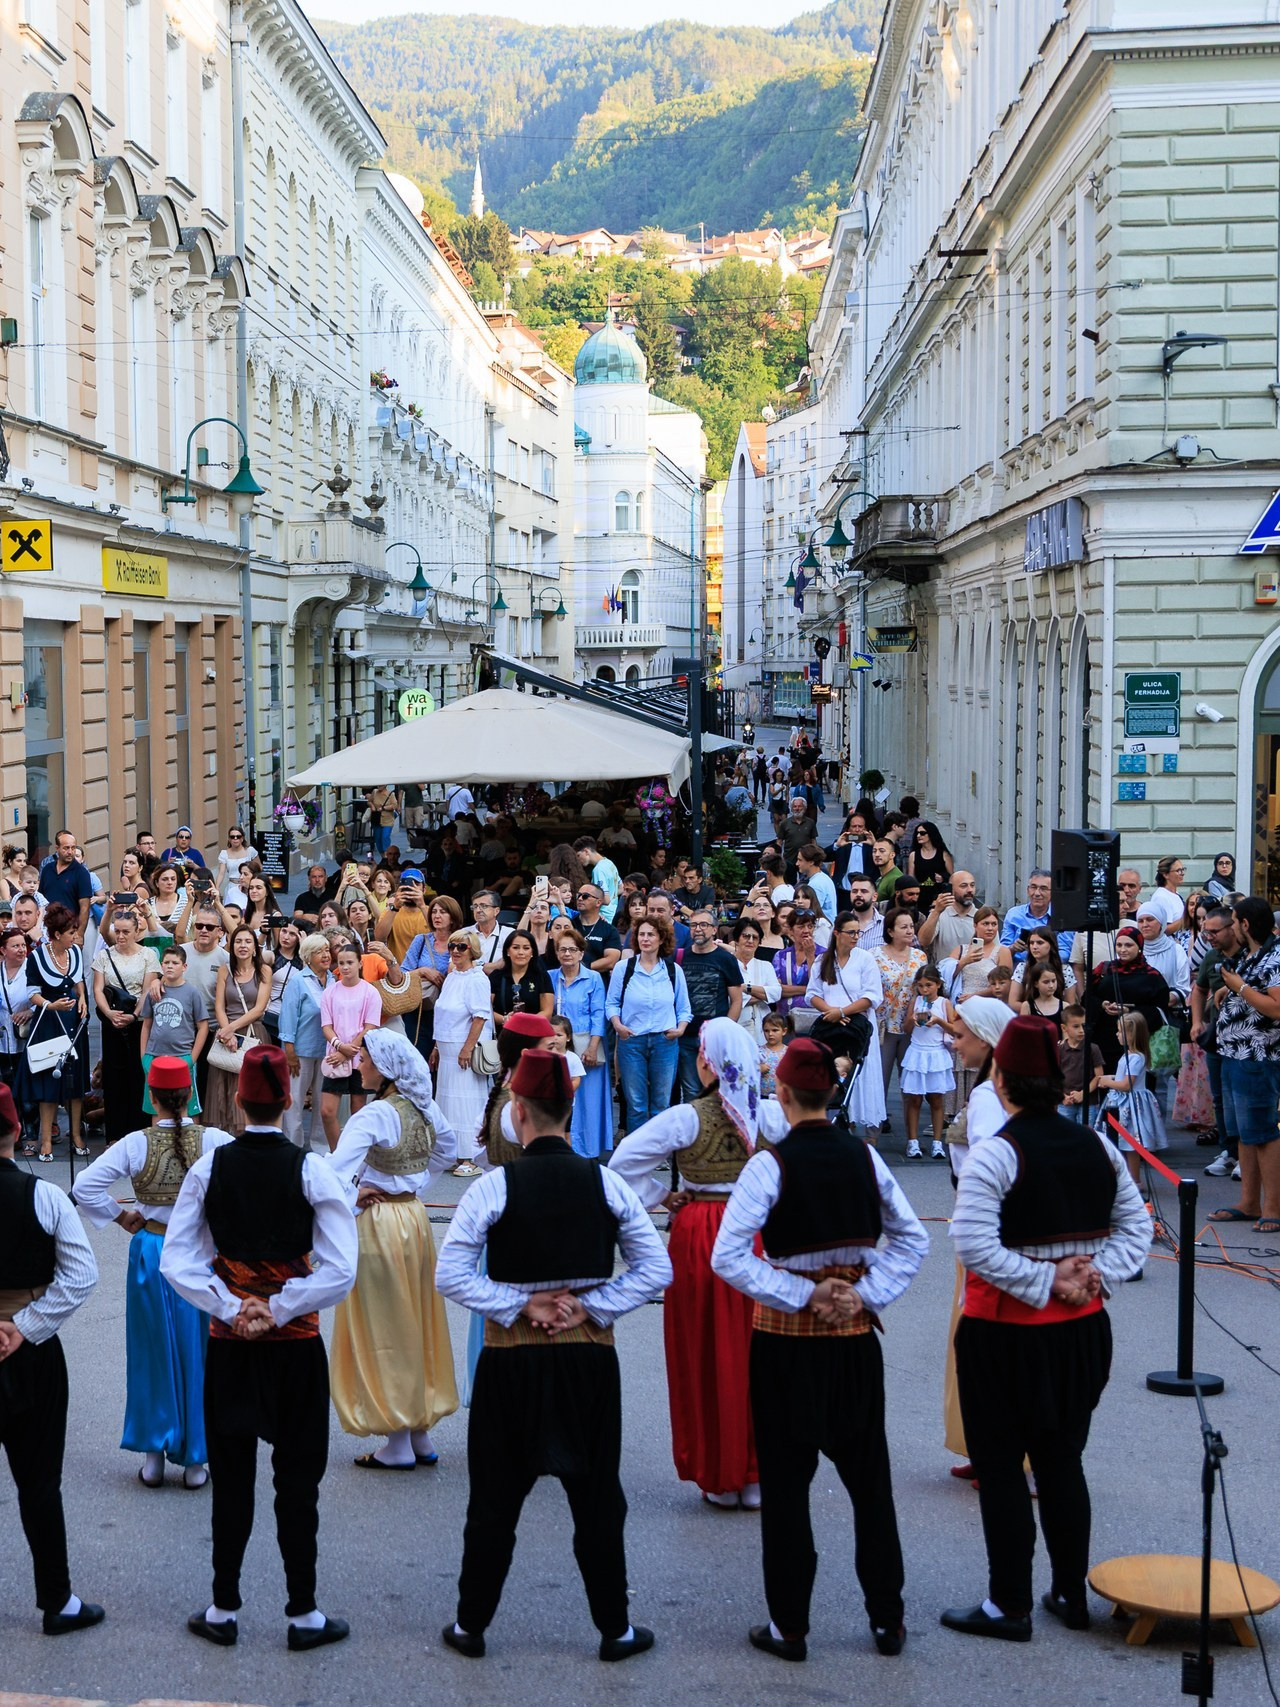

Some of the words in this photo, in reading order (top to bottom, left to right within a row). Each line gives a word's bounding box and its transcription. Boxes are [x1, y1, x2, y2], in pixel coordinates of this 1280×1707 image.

[122, 561, 148, 584] Raiffeisen
[148, 565, 162, 586] Bank
[407, 694, 427, 704] wa
